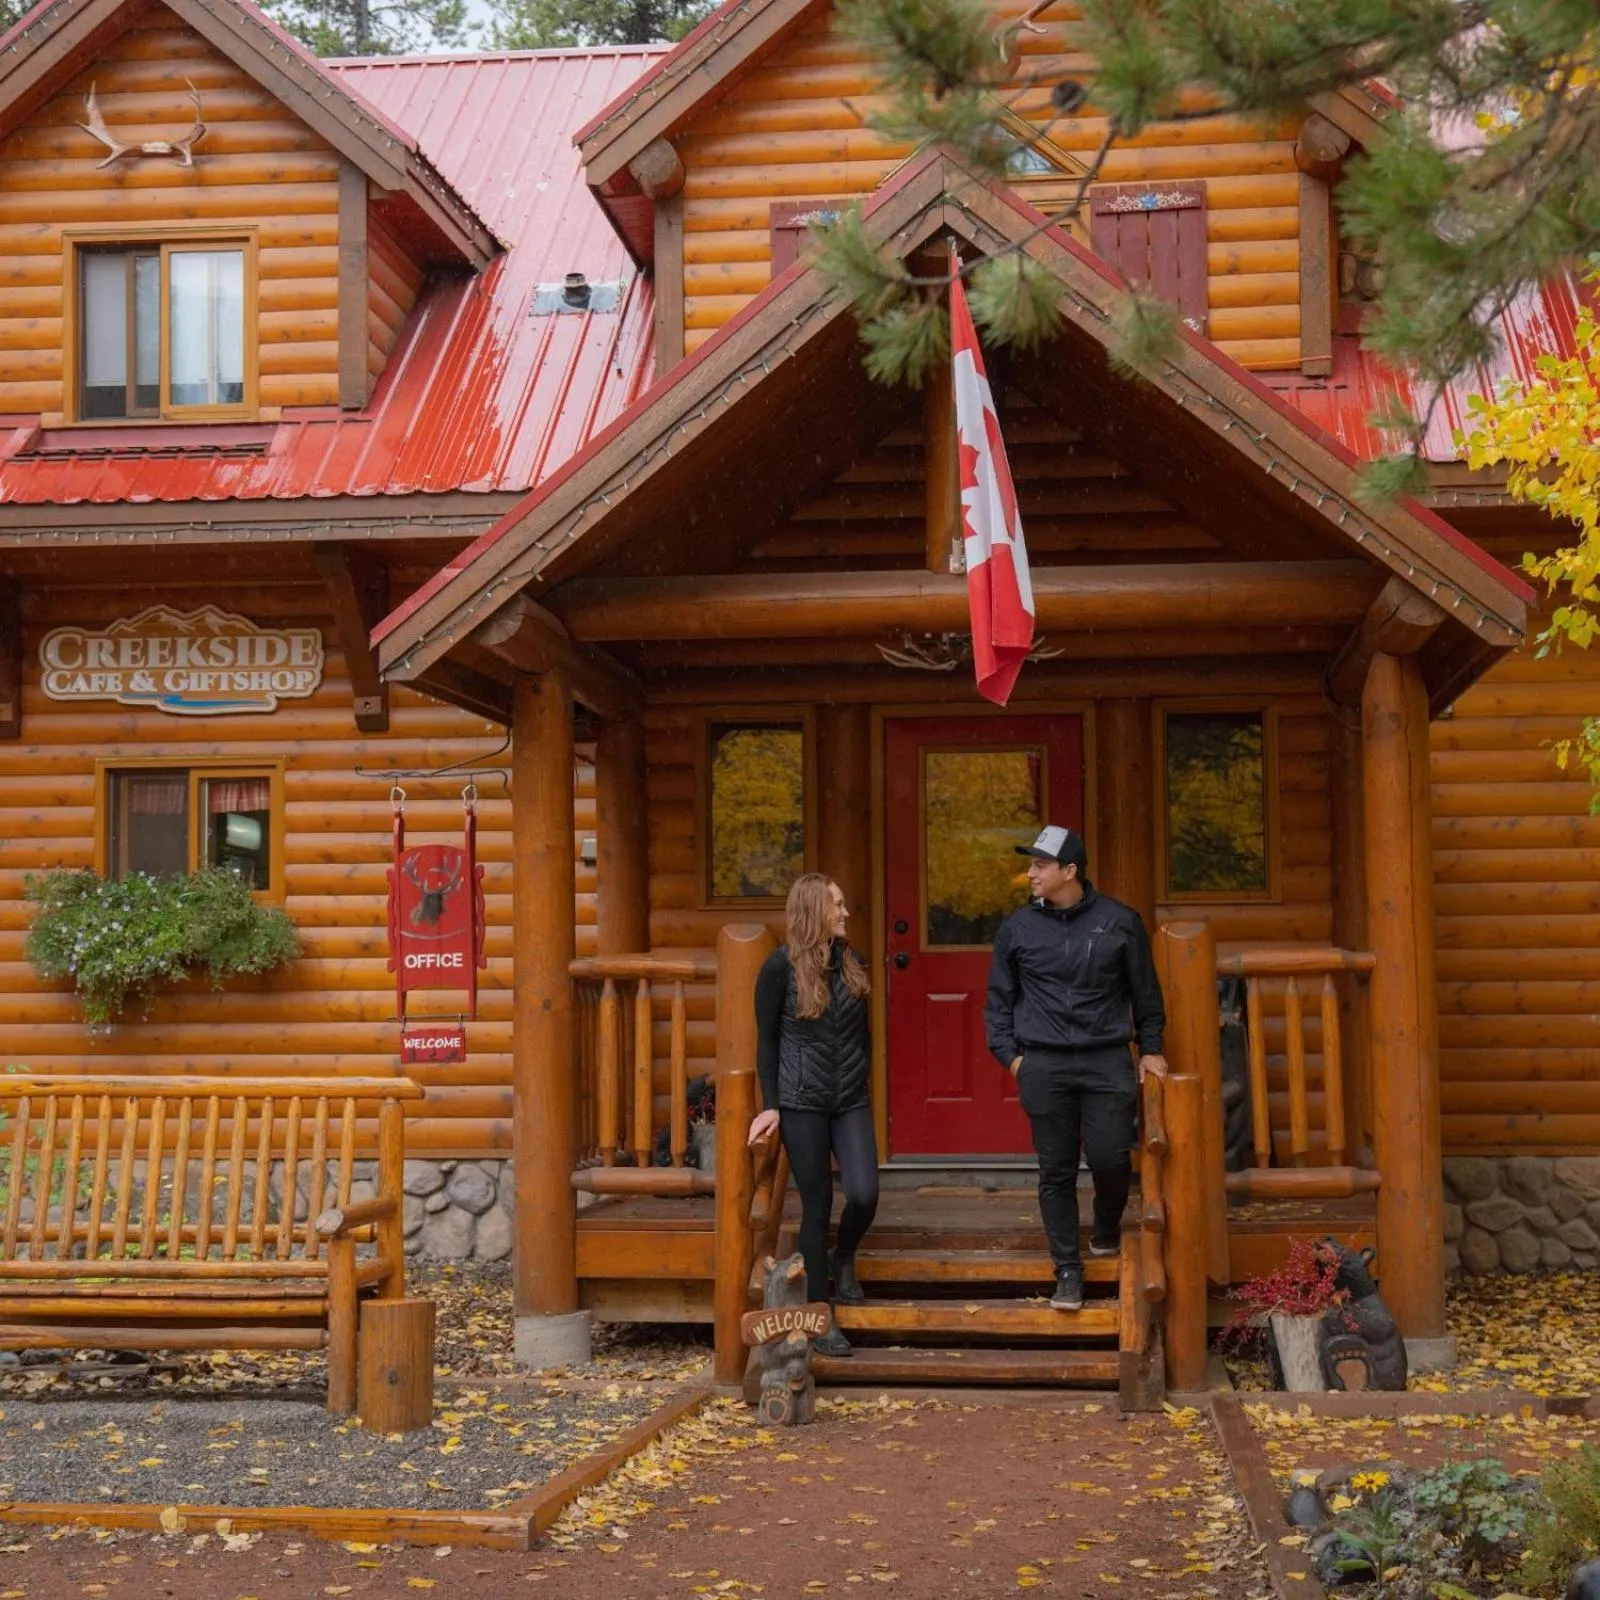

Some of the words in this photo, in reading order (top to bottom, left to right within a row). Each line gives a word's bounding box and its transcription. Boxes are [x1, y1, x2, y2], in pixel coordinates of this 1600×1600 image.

[50, 633, 317, 669] CREEKSIDE
[129, 669, 158, 692] &
[164, 670, 314, 692] GIFTSHOP
[404, 952, 464, 969] OFFICE
[403, 1037, 461, 1049] WELCOME
[752, 1310, 826, 1343] WELCOME
